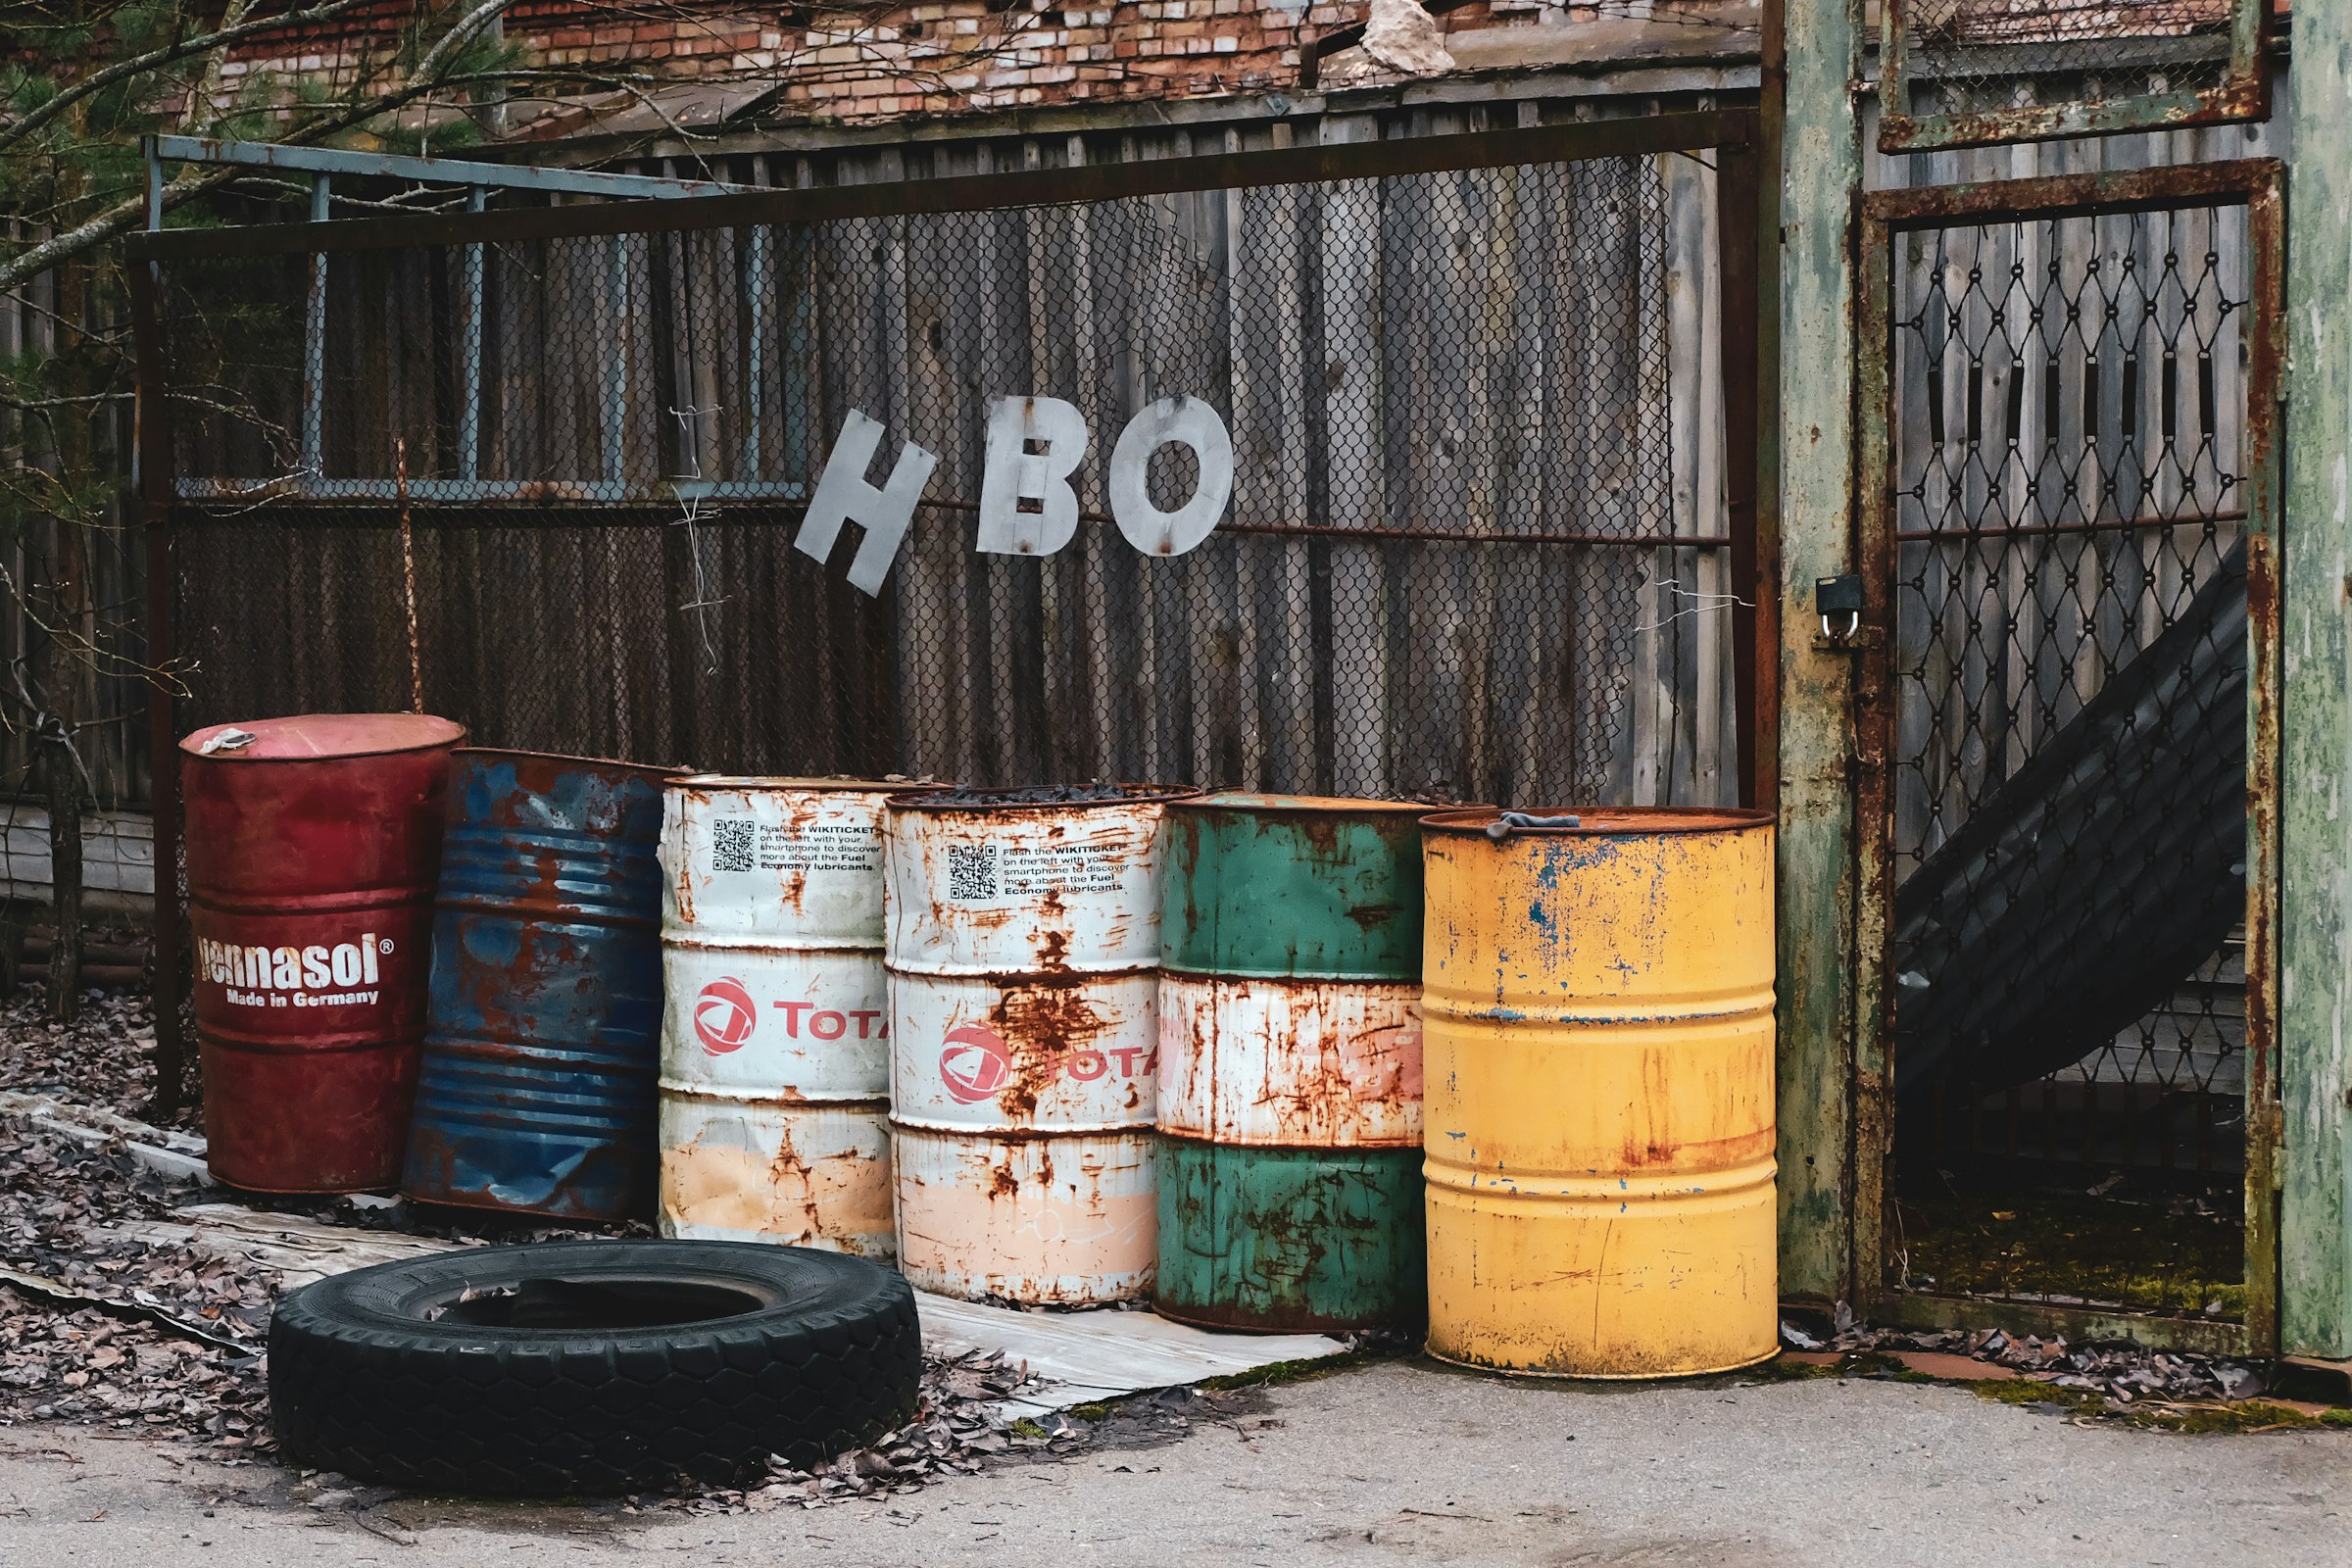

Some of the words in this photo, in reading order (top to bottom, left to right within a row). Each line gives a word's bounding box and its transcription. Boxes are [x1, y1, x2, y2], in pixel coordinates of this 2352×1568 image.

[794, 394, 1234, 599] HBO
[760, 844, 820, 853] smartphone
[1004, 848, 1031, 857] Flash
[1054, 845, 1121, 855] WIKITICKET
[1004, 865, 1068, 876] smartphone
[1087, 864, 1130, 873] discover
[1063, 883, 1125, 893] lubricants.
[226, 988, 265, 1007] Made
[270, 992, 287, 1007] in
[293, 990, 379, 1007] Germany
